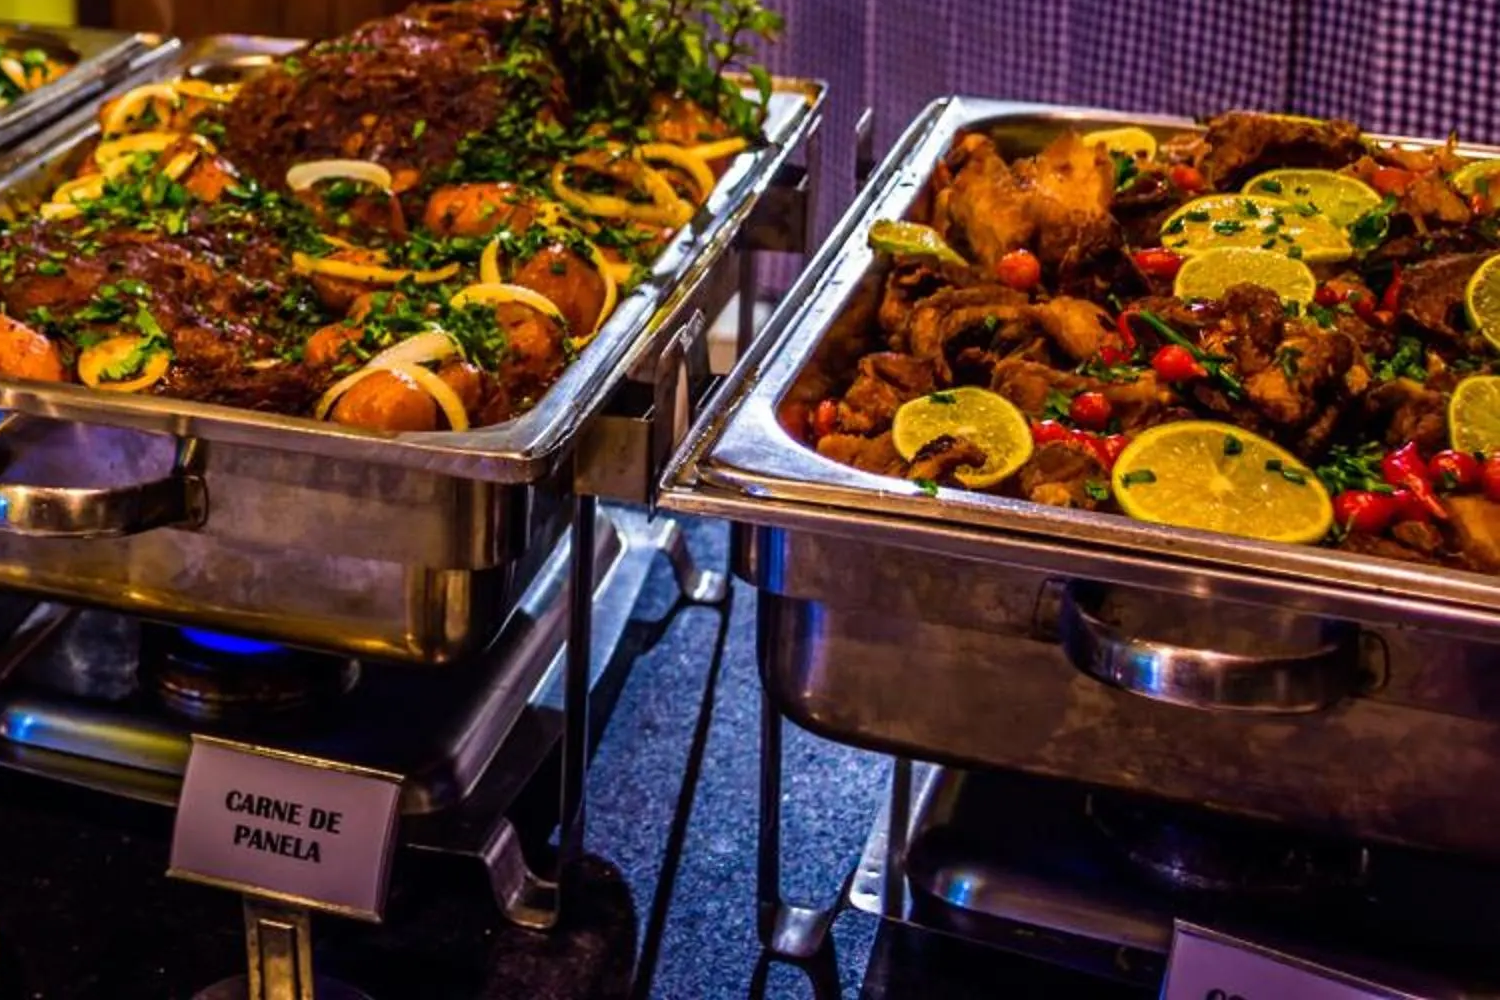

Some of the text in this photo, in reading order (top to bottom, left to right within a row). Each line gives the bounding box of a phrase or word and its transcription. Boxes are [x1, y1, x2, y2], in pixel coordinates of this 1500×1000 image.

[225, 790, 343, 834] CARNE DE
[233, 825, 321, 863] PANELA
